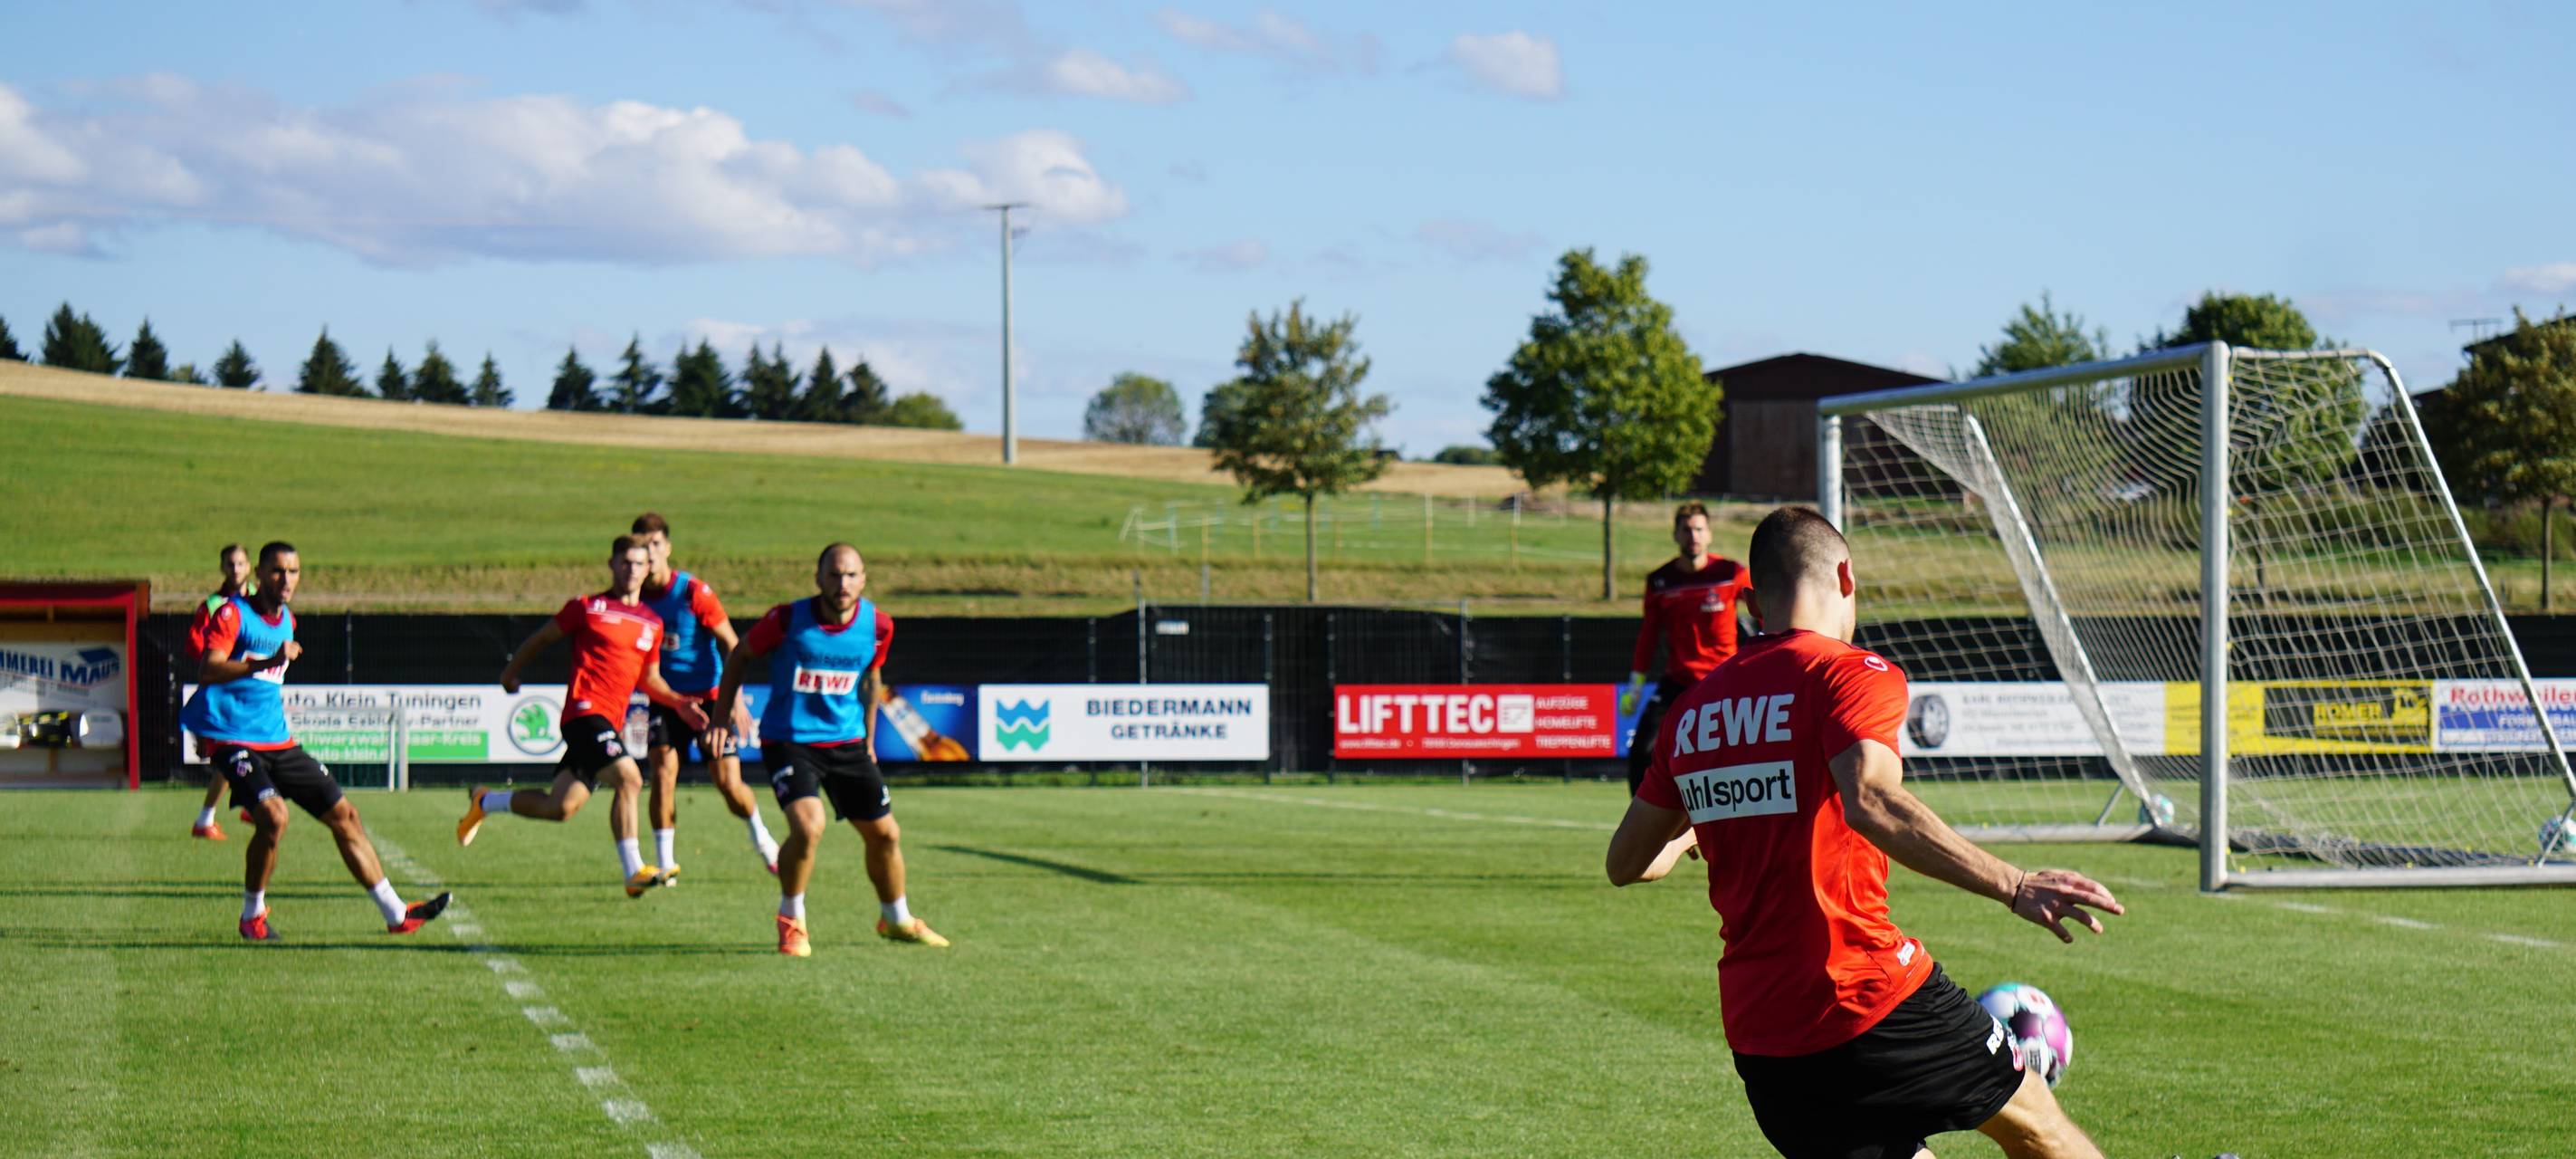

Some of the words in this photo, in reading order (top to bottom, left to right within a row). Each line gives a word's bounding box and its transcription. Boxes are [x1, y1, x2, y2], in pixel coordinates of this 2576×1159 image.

[281, 692, 316, 708] uto
[327, 692, 377, 708] Klein
[386, 692, 482, 711] Tuningen
[2451, 686, 2576, 704] Rothwile
[1086, 699, 1252, 717] BIEDERMANN
[1338, 694, 1493, 733] LIFTTEC
[1111, 722, 1228, 740] GETRÄNKE
[1674, 694, 1796, 758] REWE
[1680, 768, 1793, 813] uhlsport
